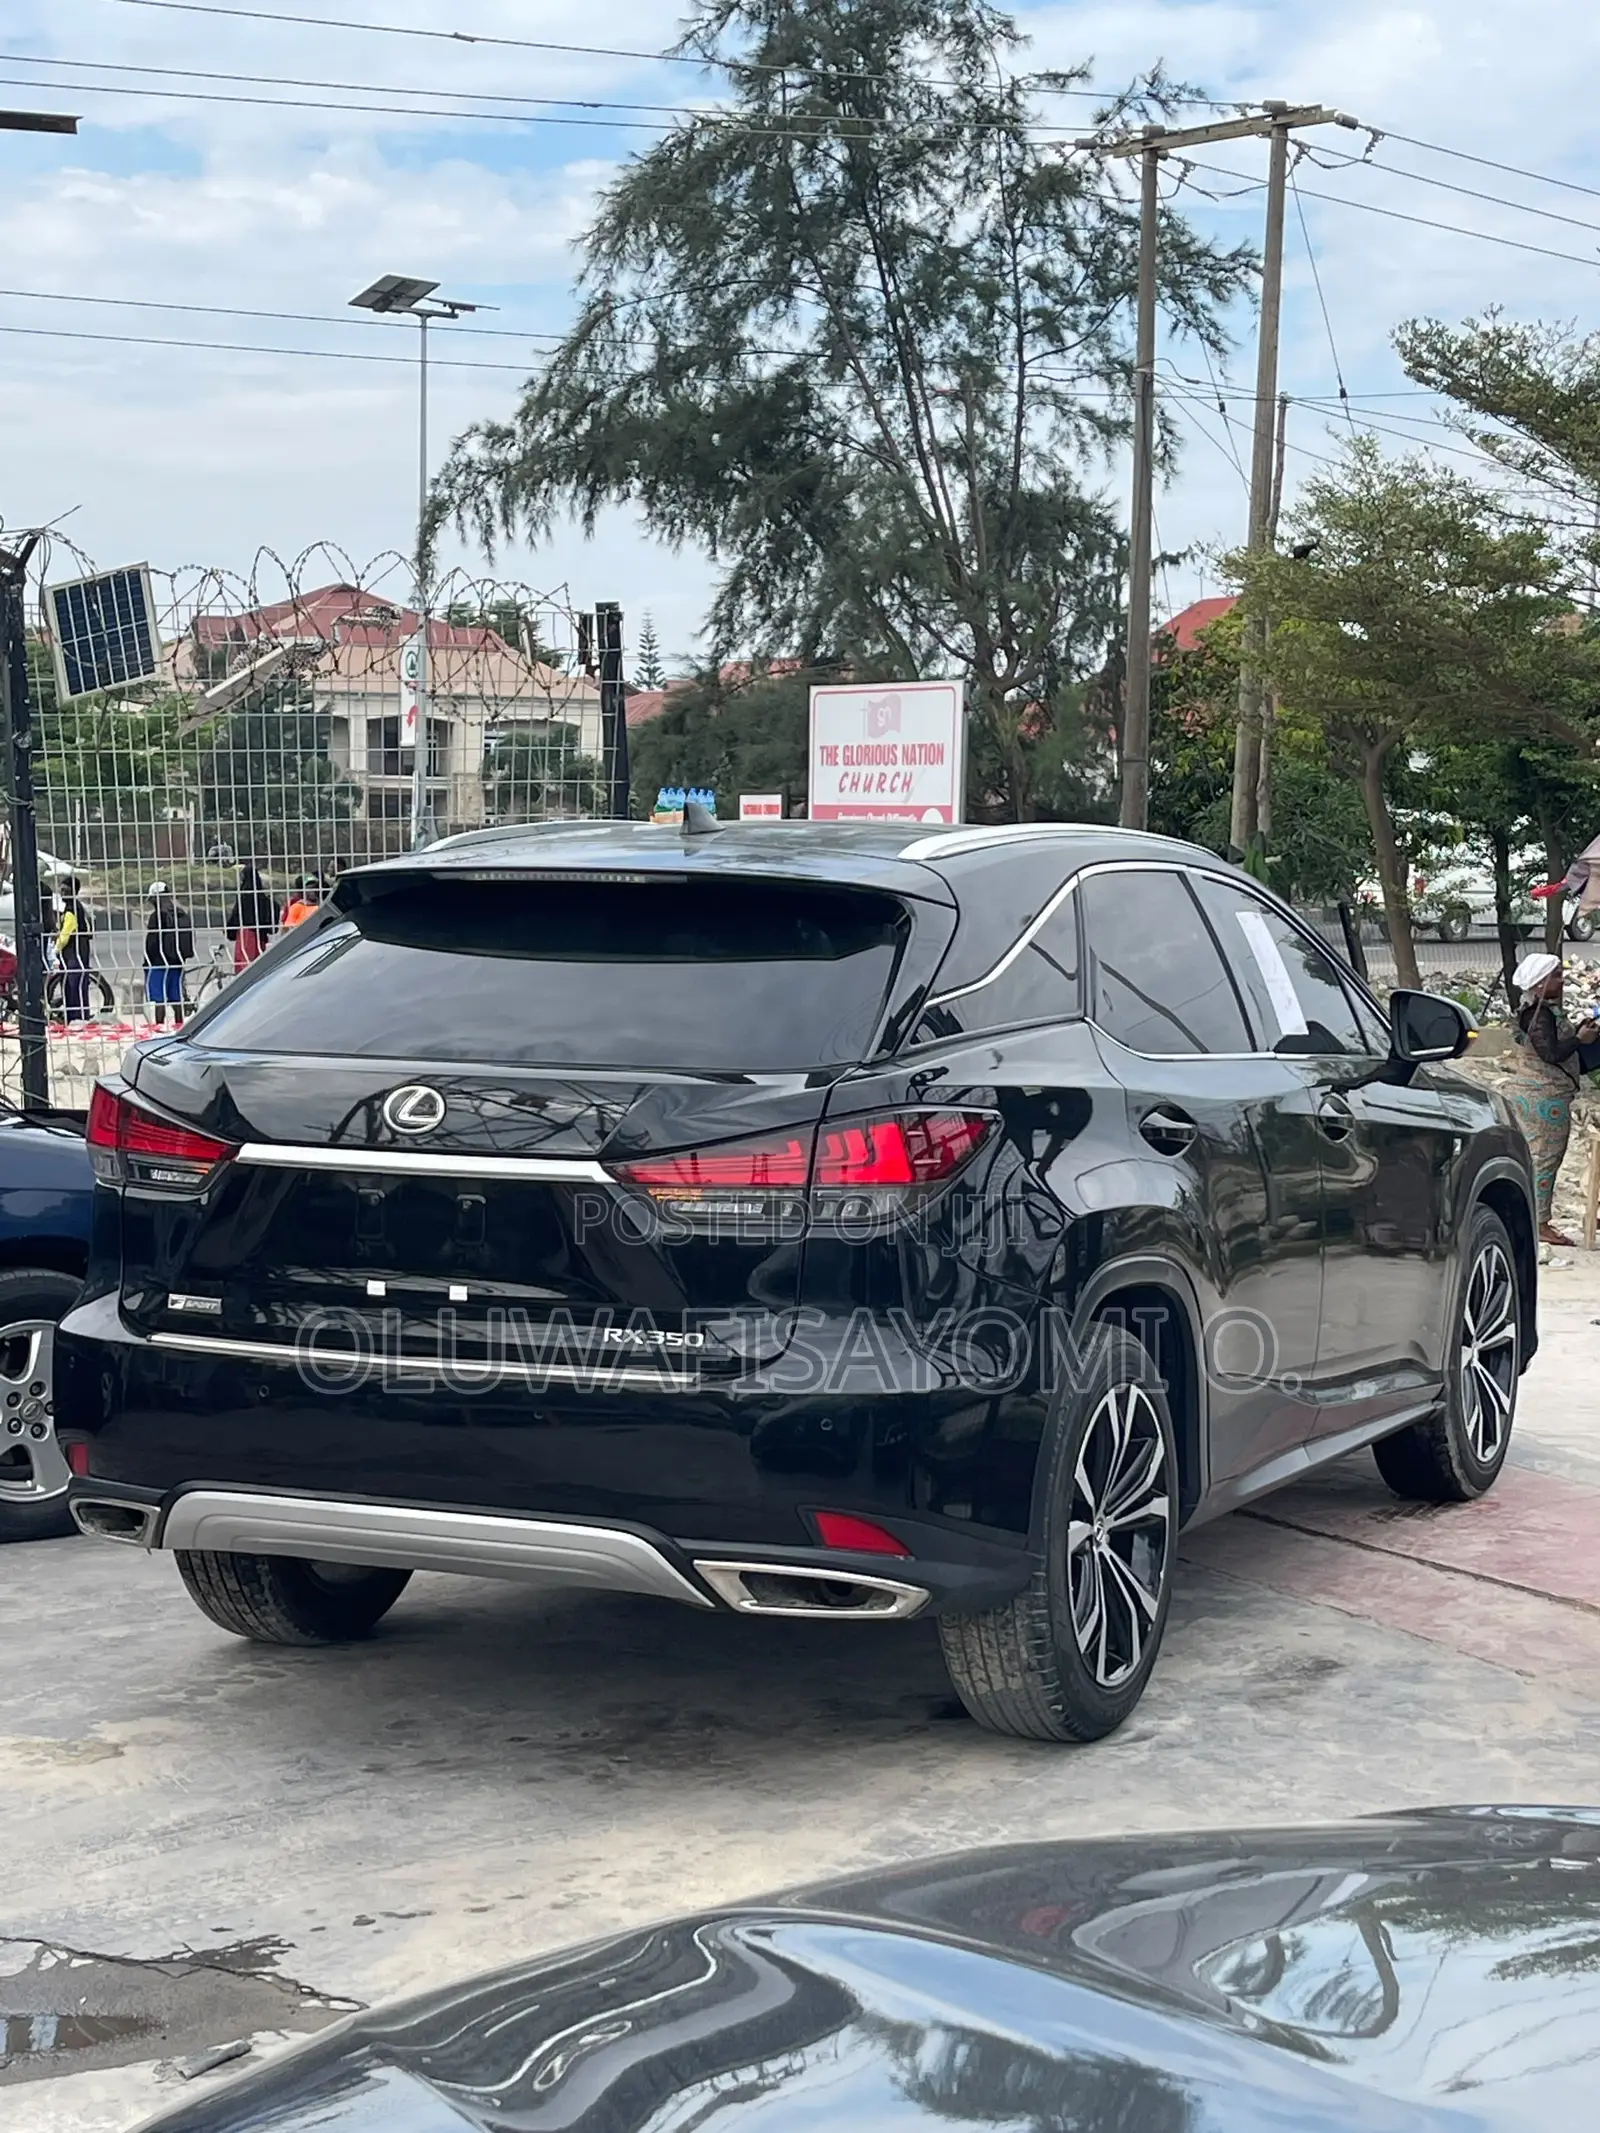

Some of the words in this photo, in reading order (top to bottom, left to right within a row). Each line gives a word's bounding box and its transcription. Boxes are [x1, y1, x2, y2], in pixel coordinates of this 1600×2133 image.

[819, 744, 839, 767] THE
[842, 743, 898, 767] GLORIOUS
[901, 742, 945, 766] NATION
[838, 770, 914, 794] CHURCH
